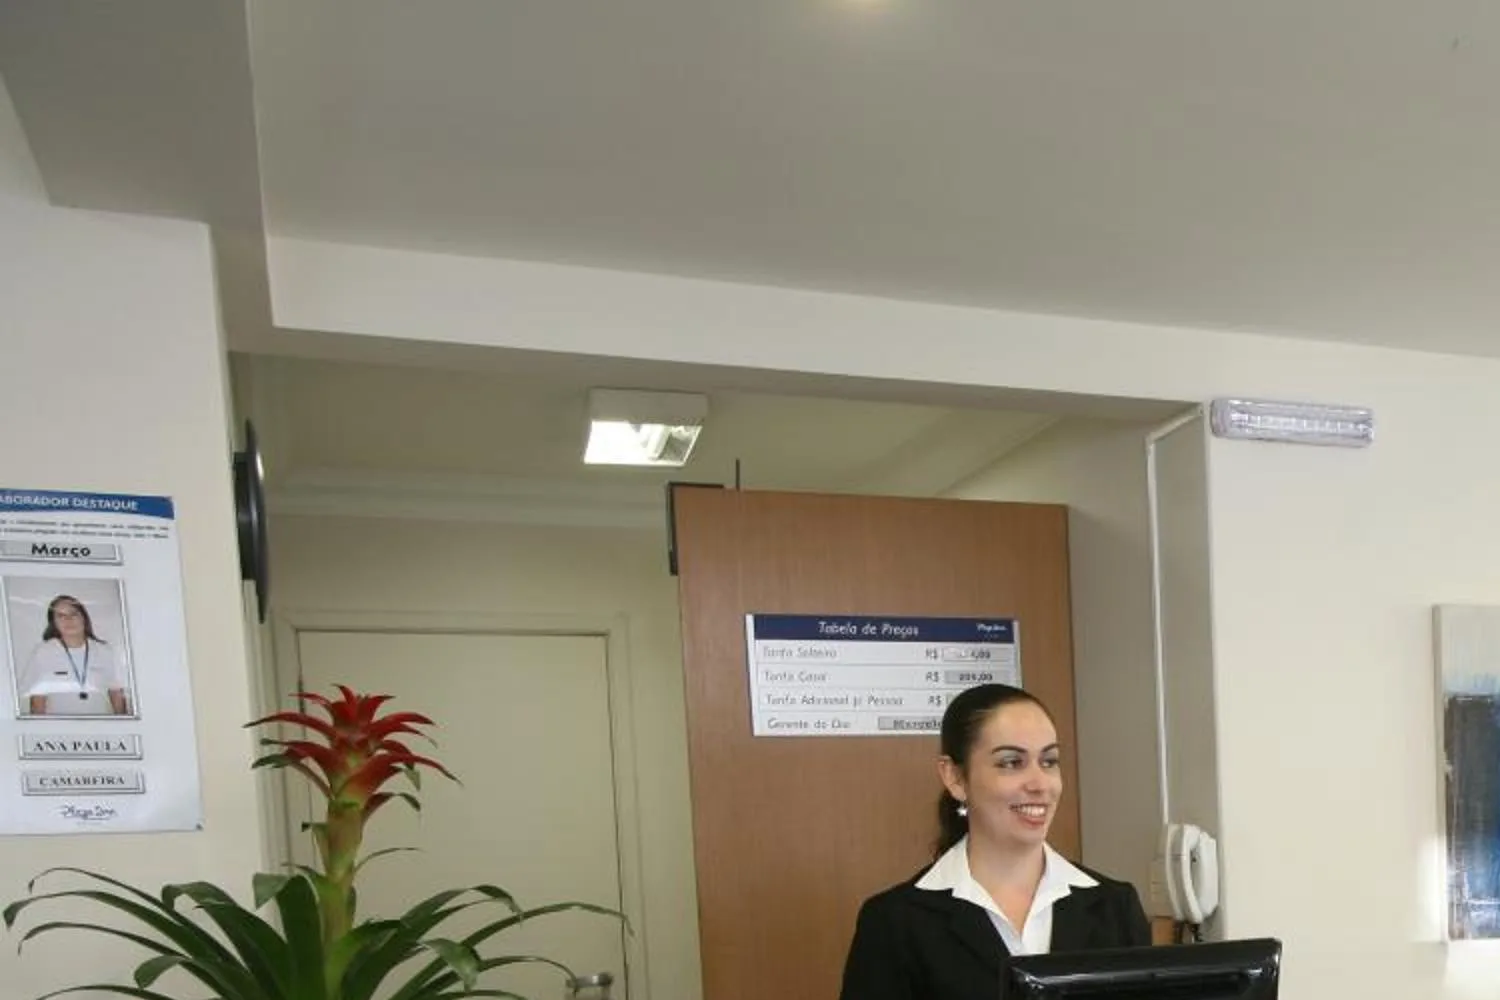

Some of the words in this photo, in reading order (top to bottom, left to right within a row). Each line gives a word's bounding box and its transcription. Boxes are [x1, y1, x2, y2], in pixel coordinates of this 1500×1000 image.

[73, 496, 138, 511] DESTAQUE
[31, 543, 91, 558] Março
[818, 621, 857, 634] Tabela
[861, 623, 877, 635] de
[880, 623, 919, 638] Preços
[925, 648, 938, 660] R$
[926, 671, 939, 683] R$
[928, 695, 942, 706] R$
[34, 740, 67, 752] ANA
[73, 740, 127, 752] PAULA
[39, 775, 125, 786] CAMAREIRA
